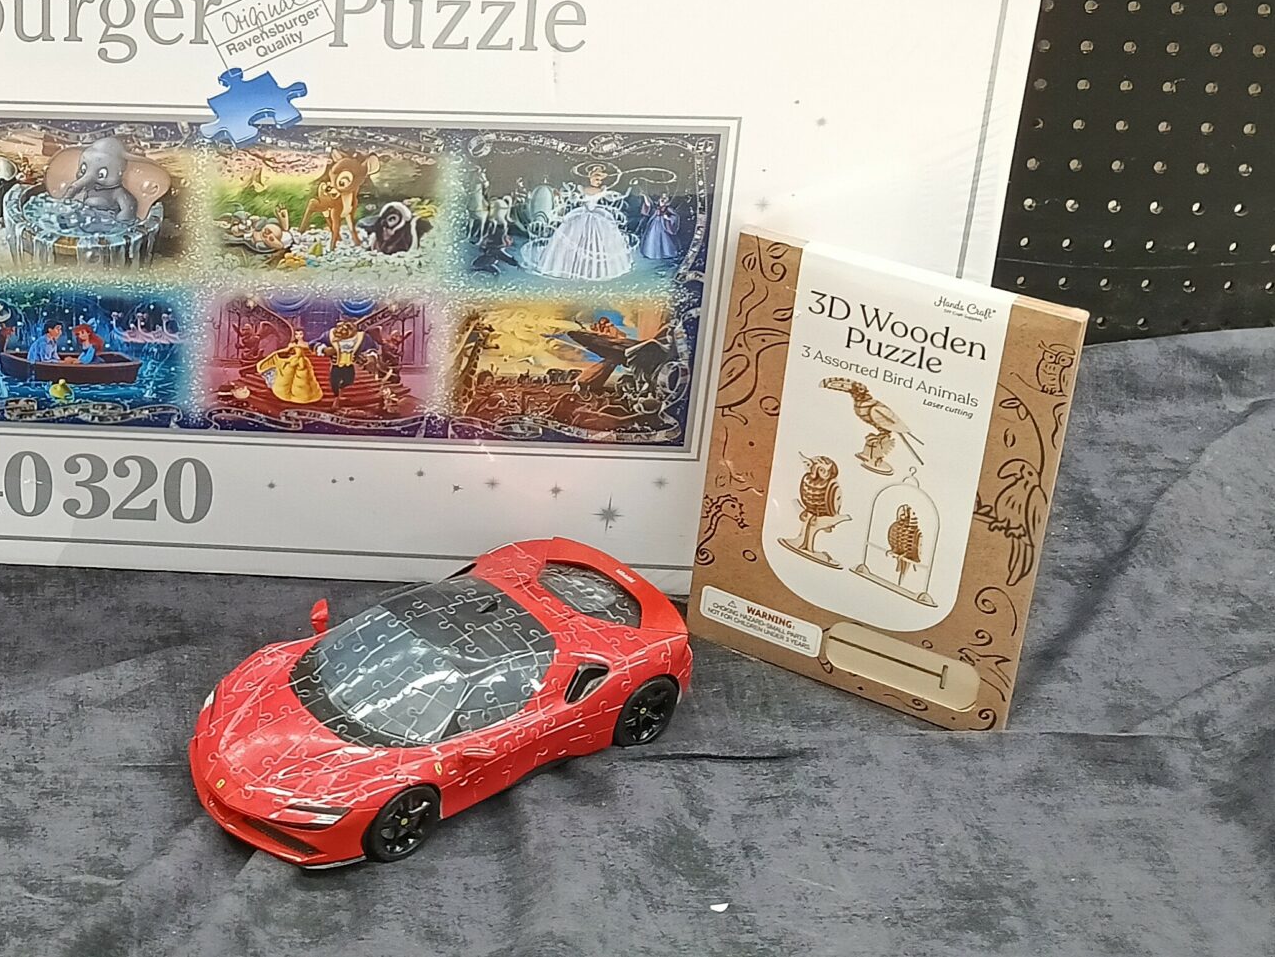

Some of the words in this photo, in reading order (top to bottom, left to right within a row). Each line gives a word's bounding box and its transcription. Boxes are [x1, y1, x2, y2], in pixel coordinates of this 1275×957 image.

[226, 7, 322, 57] Ravensburger
[256, 30, 304, 59] Quality
[933, 296, 965, 311] Hands
[966, 303, 992, 320] Craft
[808, 290, 851, 321] 3D
[859, 304, 987, 361] Wooden
[845, 326, 942, 374] Puzzle
[801, 345, 811, 358] 3
[813, 350, 879, 379] Assorted
[882, 369, 914, 390] Bird
[916, 380, 979, 407] Animals
[922, 398, 945, 412] Laser
[944, 405, 974, 420] cutting
[707, 607, 720, 616] NOT
[720, 611, 733, 620] FOR
[733, 616, 763, 633] CHILDREN
[763, 627, 785, 641] UNDER
[712, 602, 739, 617] CHOKING
